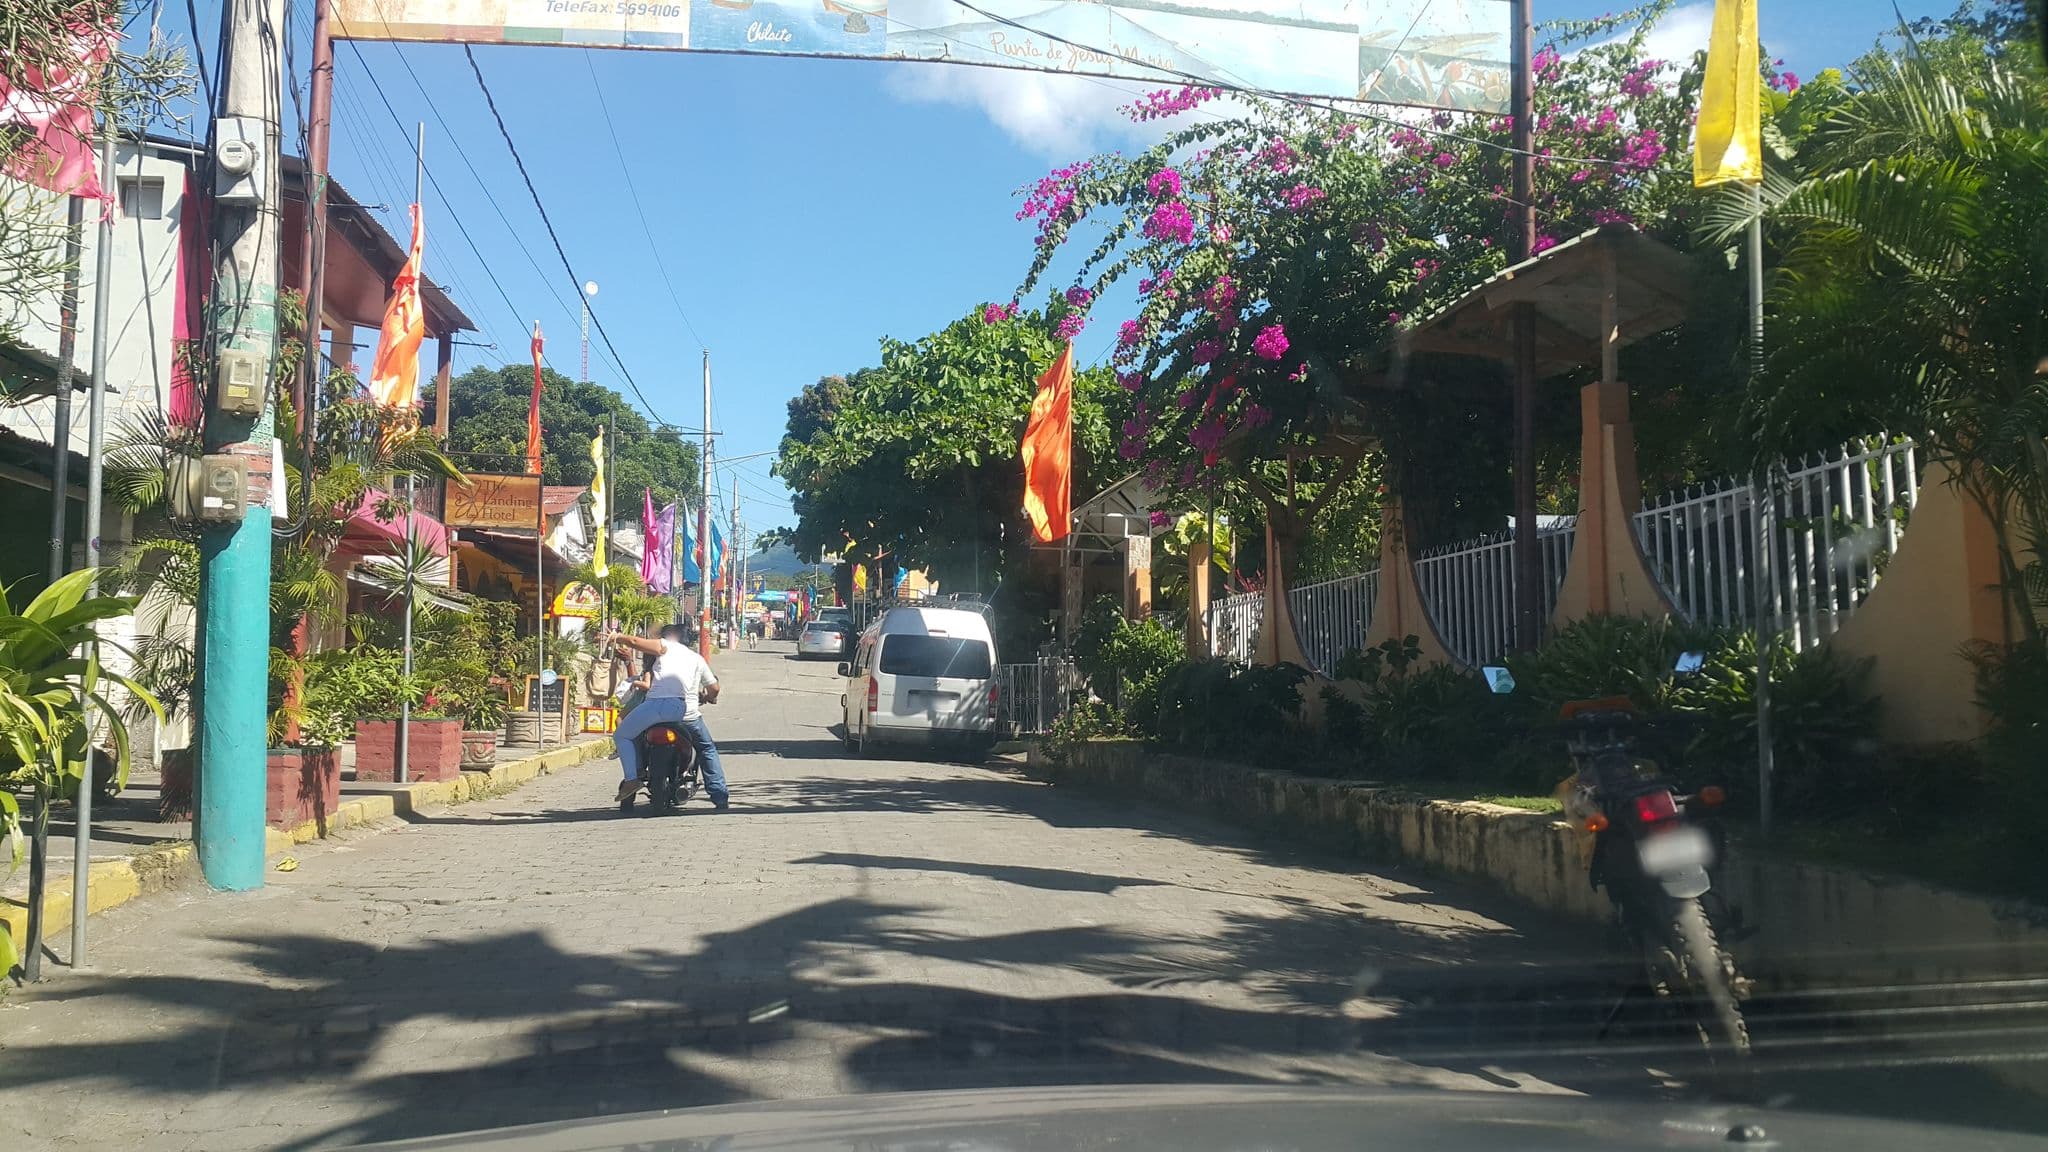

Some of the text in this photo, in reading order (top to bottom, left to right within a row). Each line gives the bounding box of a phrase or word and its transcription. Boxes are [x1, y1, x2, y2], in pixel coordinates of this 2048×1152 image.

[615, 2, 680, 17] 5694106
[991, 31, 1042, 57] Punta
[1046, 40, 1062, 60] de
[483, 494, 533, 509] Landing
[482, 507, 515, 521] Hotel
